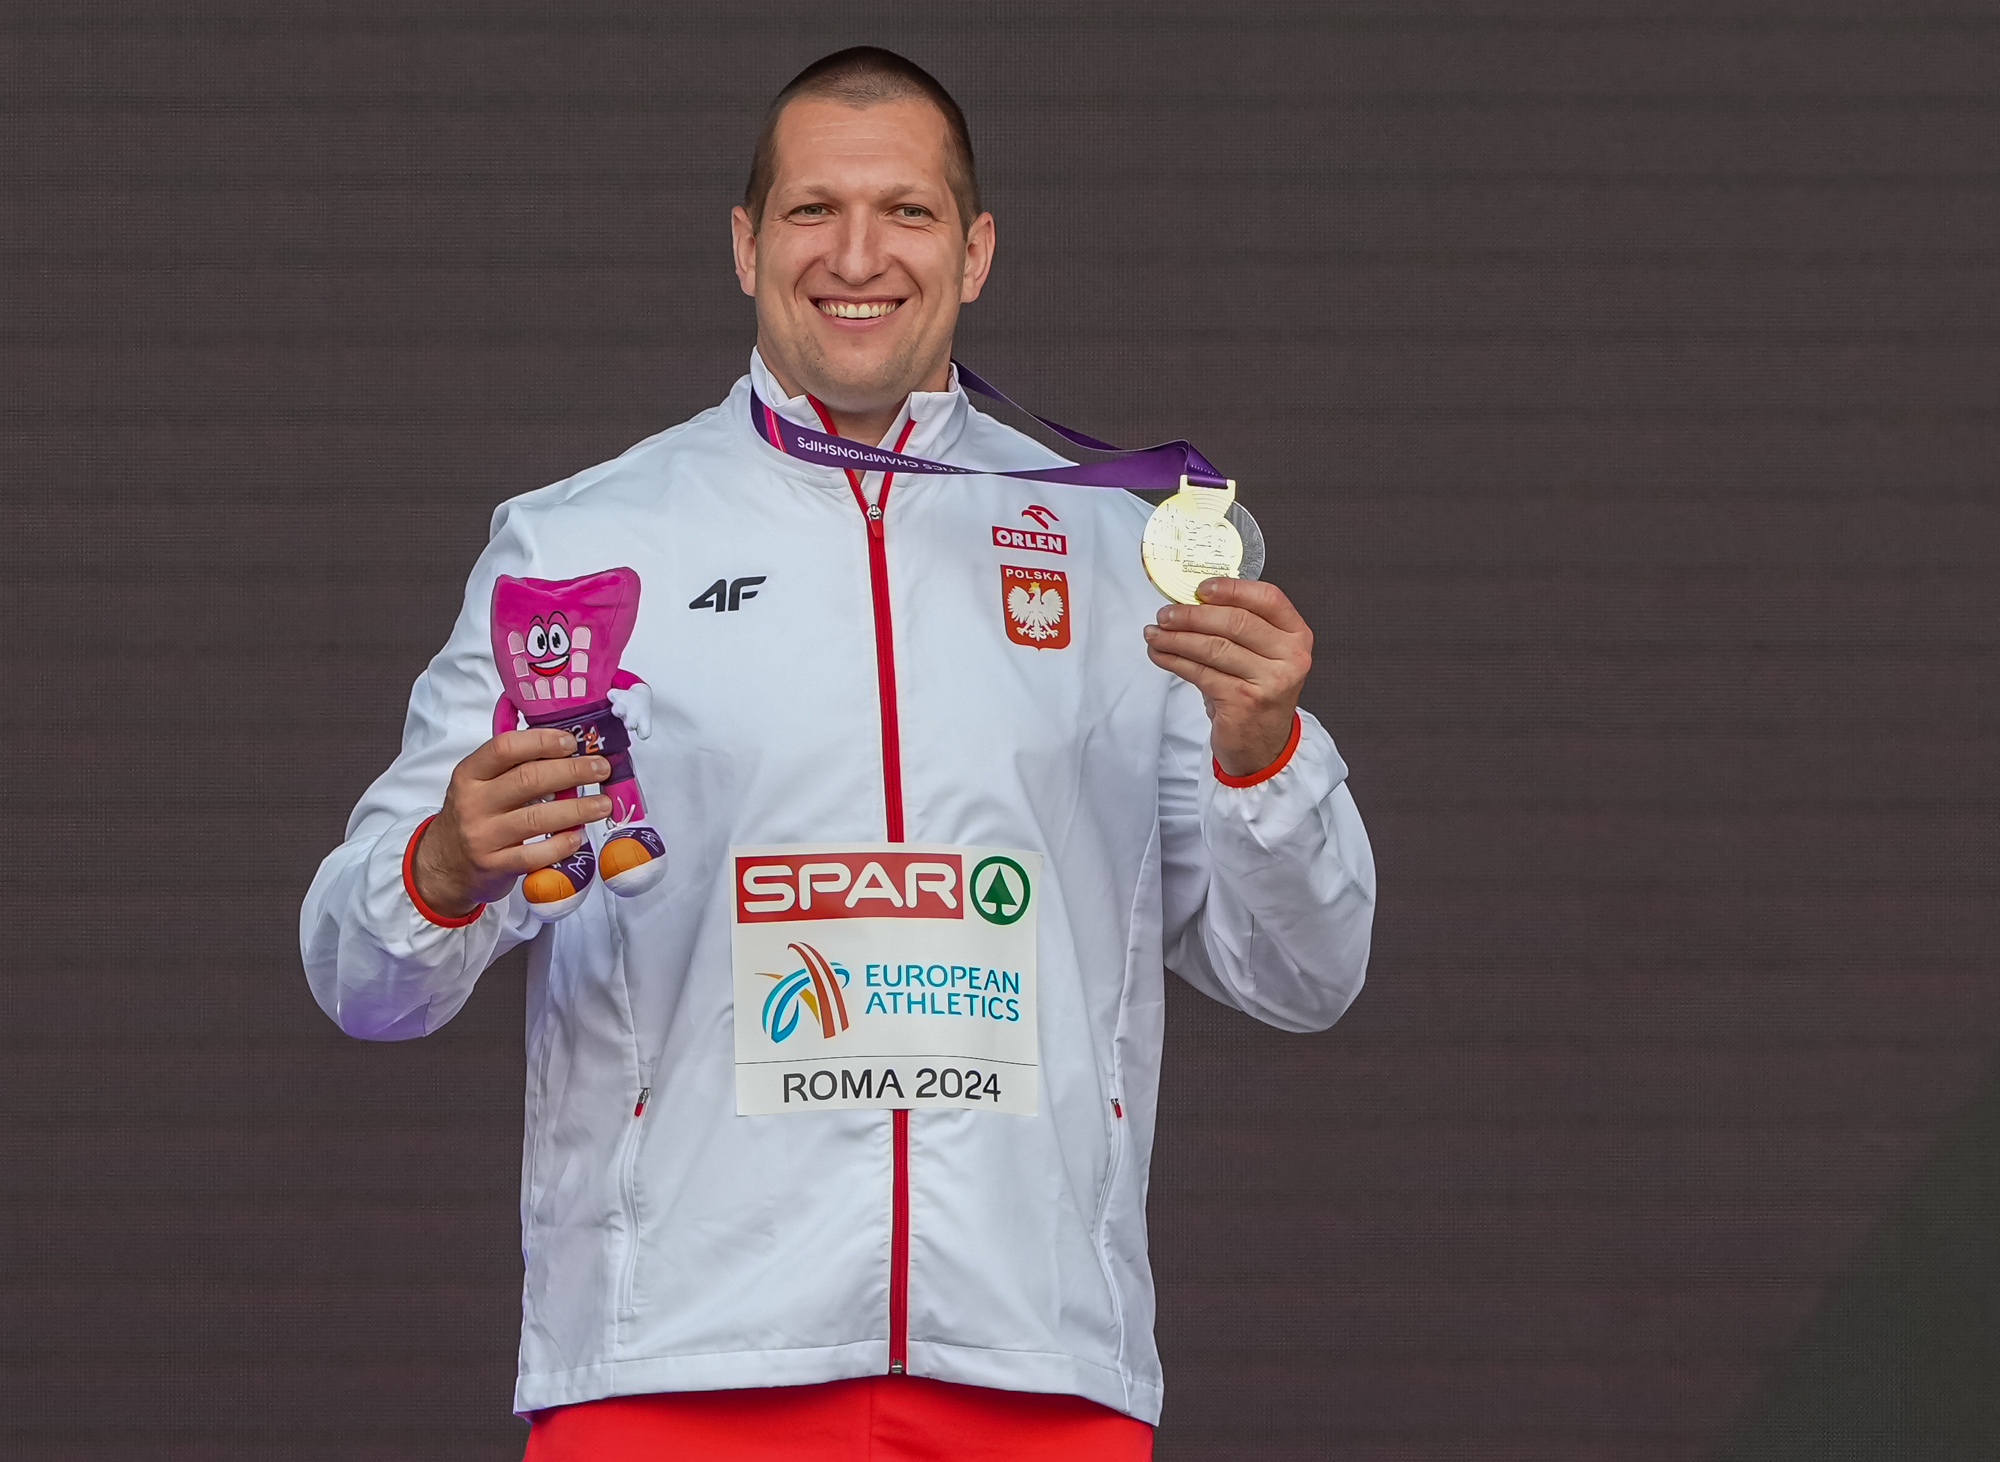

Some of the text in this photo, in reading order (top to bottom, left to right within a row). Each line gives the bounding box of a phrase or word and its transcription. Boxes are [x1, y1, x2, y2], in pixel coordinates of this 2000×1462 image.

[797, 436, 919, 468] CHAMPIONSHIPS
[996, 529, 1063, 552] ORLEN
[1005, 568, 1063, 582] POLSKA
[688, 575, 767, 613] 4F
[742, 861, 958, 913] SPAR
[865, 964, 1020, 995] EUROPEAN
[865, 992, 1020, 1022] ATHLETICS
[783, 1068, 1002, 1103] ROMA 2024
